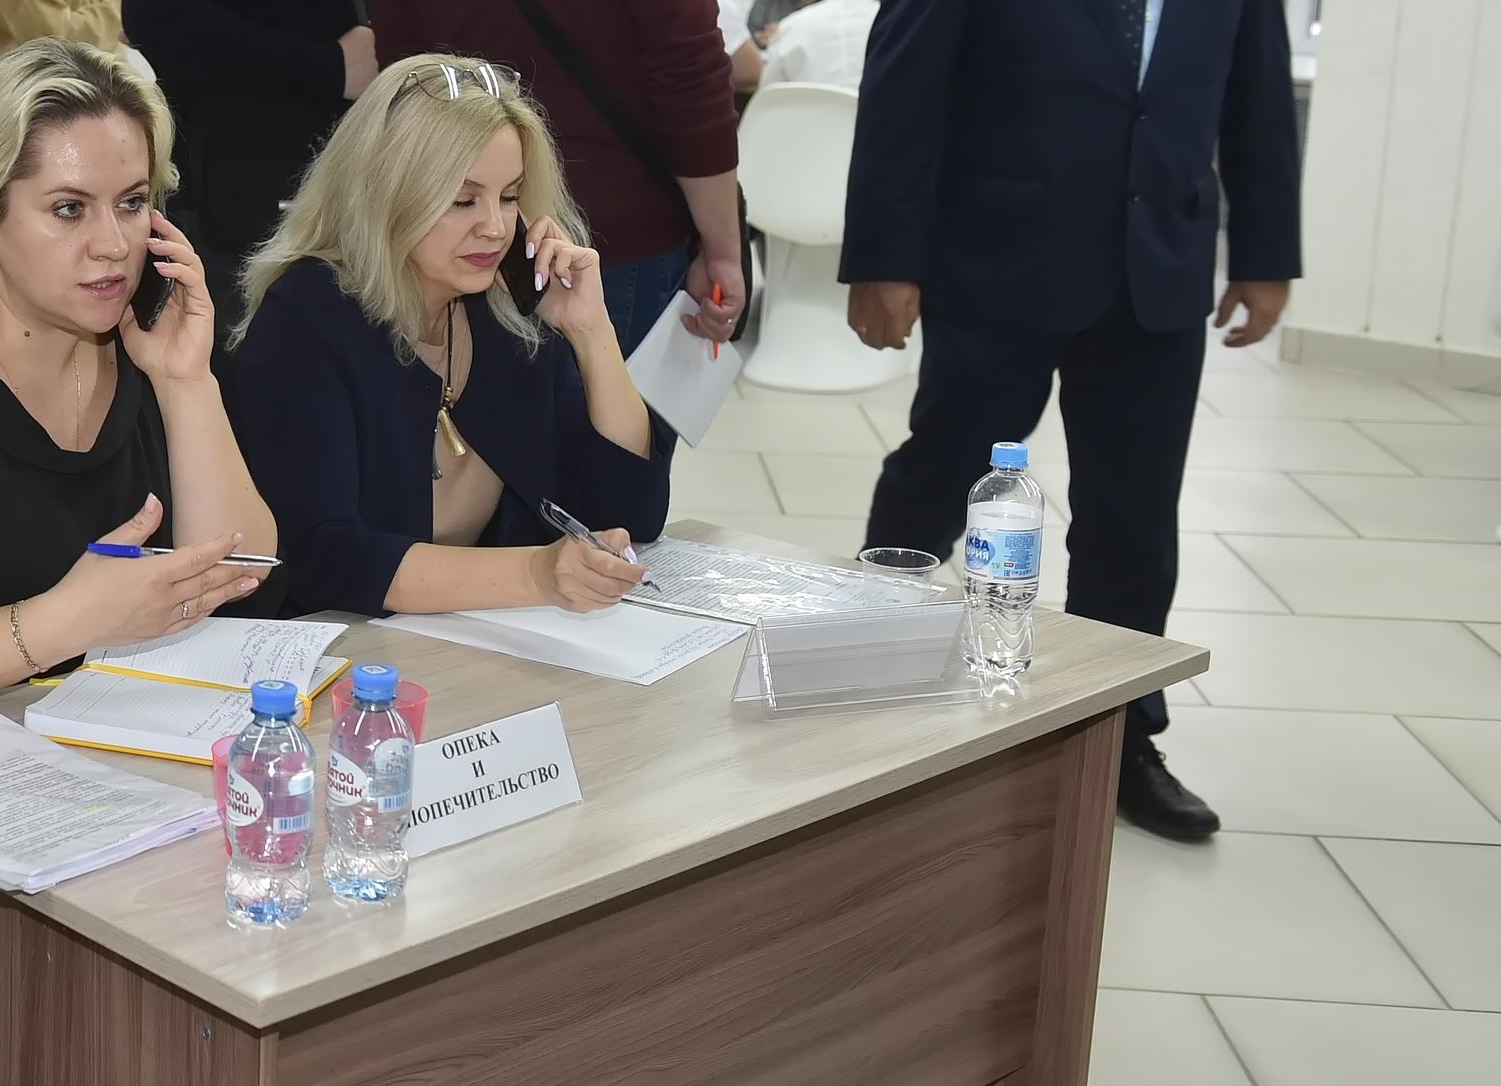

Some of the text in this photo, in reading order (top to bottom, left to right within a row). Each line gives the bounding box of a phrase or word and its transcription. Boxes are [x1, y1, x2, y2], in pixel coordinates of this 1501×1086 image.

[967, 535, 989, 551] КВА
[966, 546, 989, 561] ОРИЯ
[441, 729, 501, 760] ОПЕКА
[471, 760, 487, 778] И
